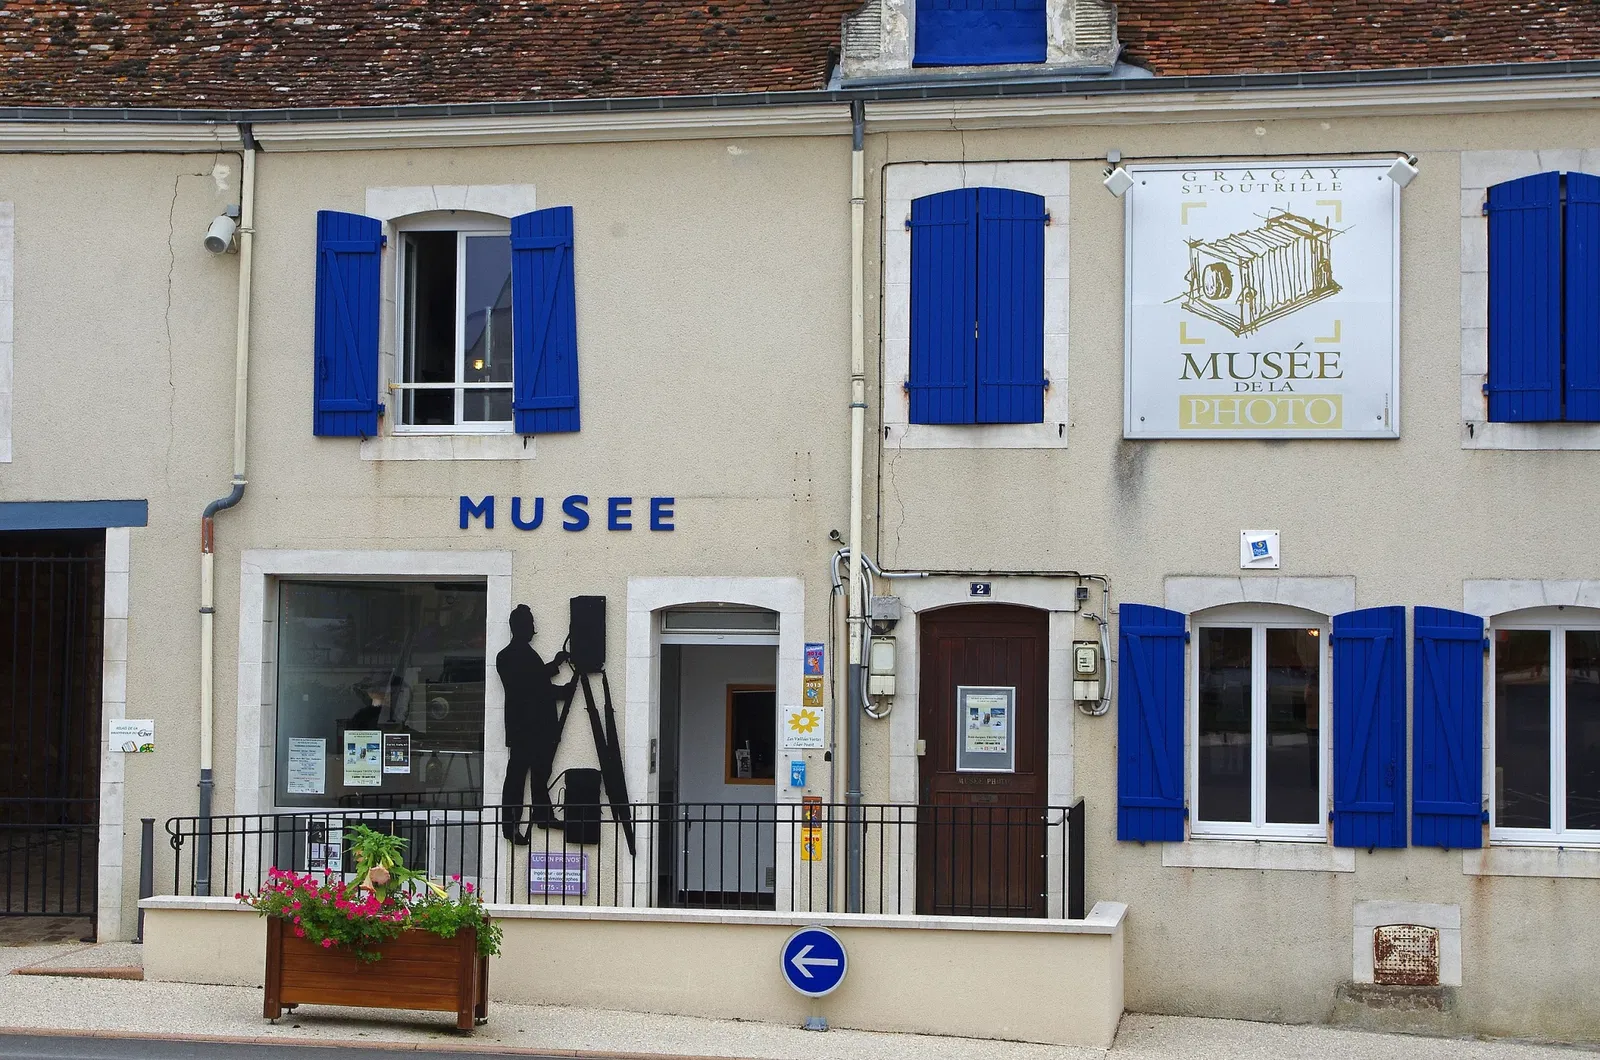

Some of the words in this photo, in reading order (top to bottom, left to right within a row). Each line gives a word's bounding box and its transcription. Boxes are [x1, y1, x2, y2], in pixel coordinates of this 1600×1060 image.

[1182, 169, 1342, 182] GRAÇAY
[1182, 182, 1343, 194] ST-OUTRILLE
[1178, 342, 1344, 380] MUSÉE
[1233, 382, 1263, 393] DE
[1269, 381, 1294, 393] LA
[1187, 398, 1337, 426] PHOTO
[459, 494, 675, 532] MUSEE
[976, 584, 984, 594] 2
